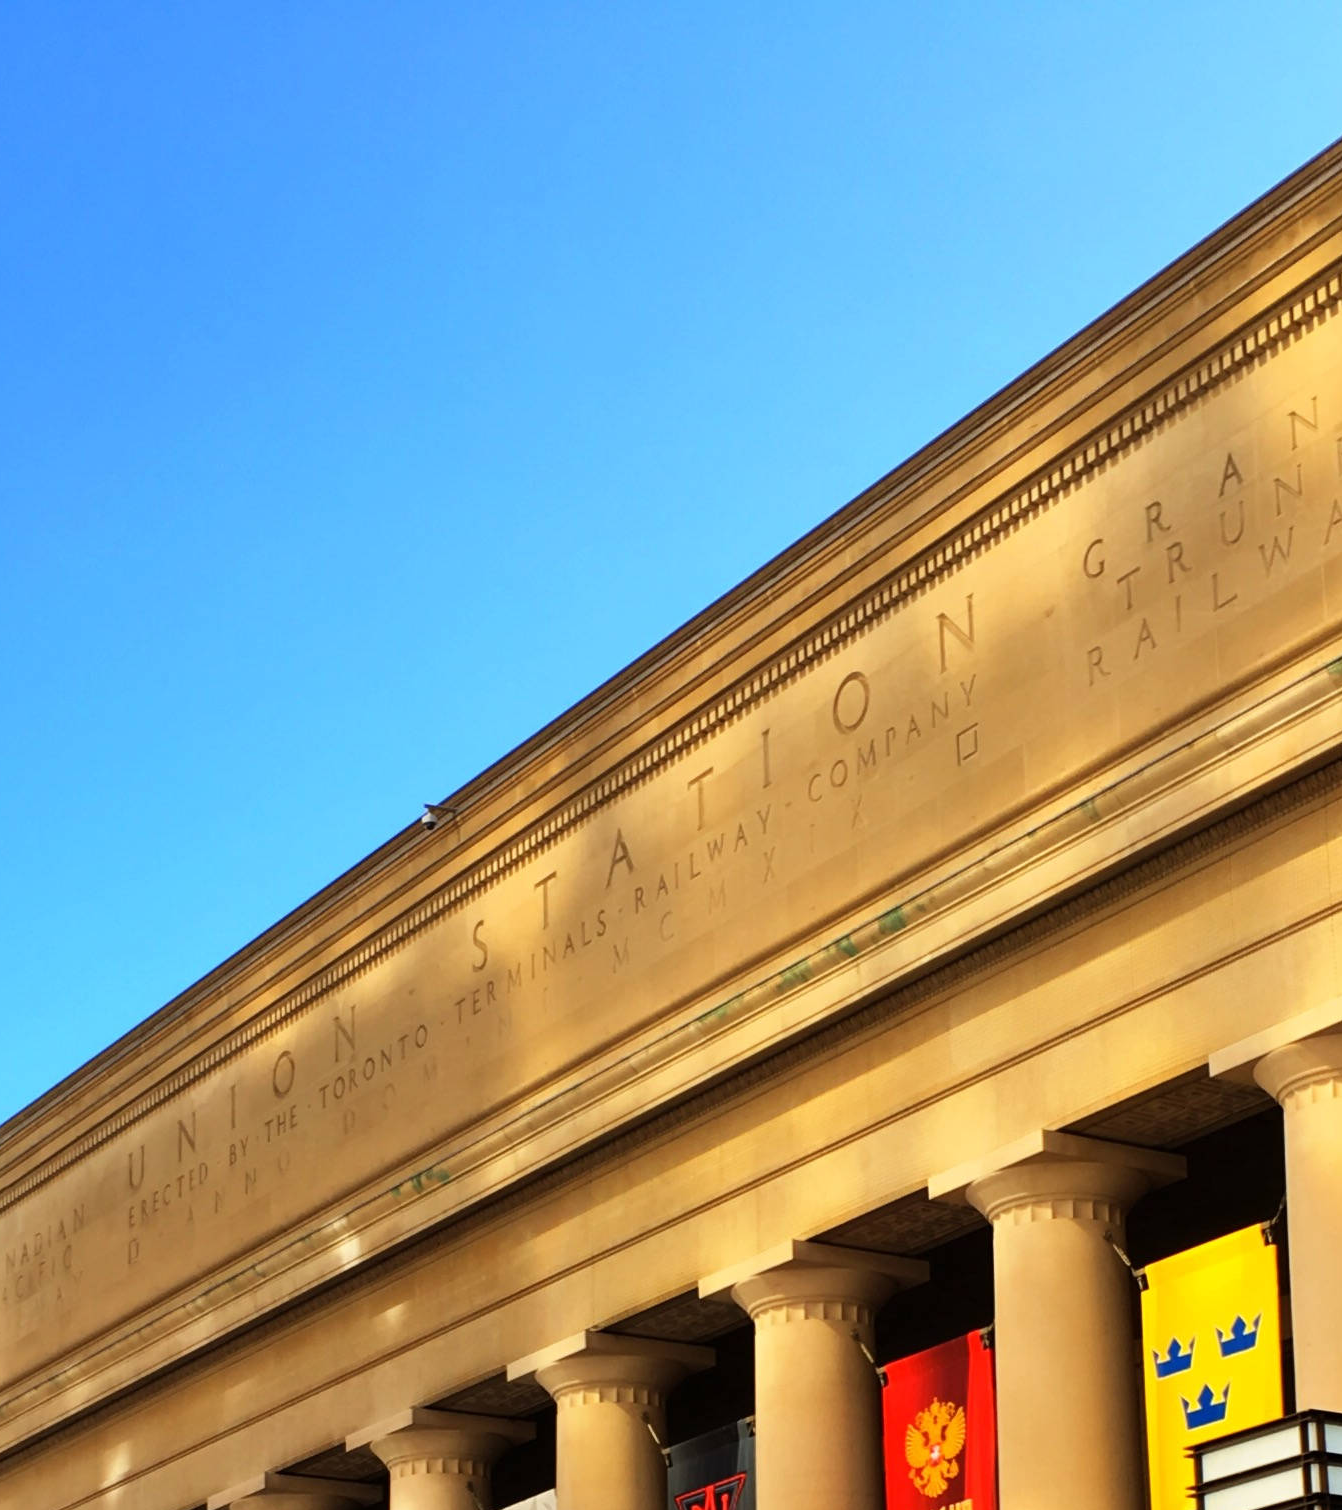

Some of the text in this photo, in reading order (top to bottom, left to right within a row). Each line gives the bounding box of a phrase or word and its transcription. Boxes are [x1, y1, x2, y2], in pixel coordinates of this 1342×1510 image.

[128, 592, 977, 1190] UNION STATION
[129, 675, 977, 1227] ERECTED BY THE TORONTO TERMINALS RAILWAY COMPANY
